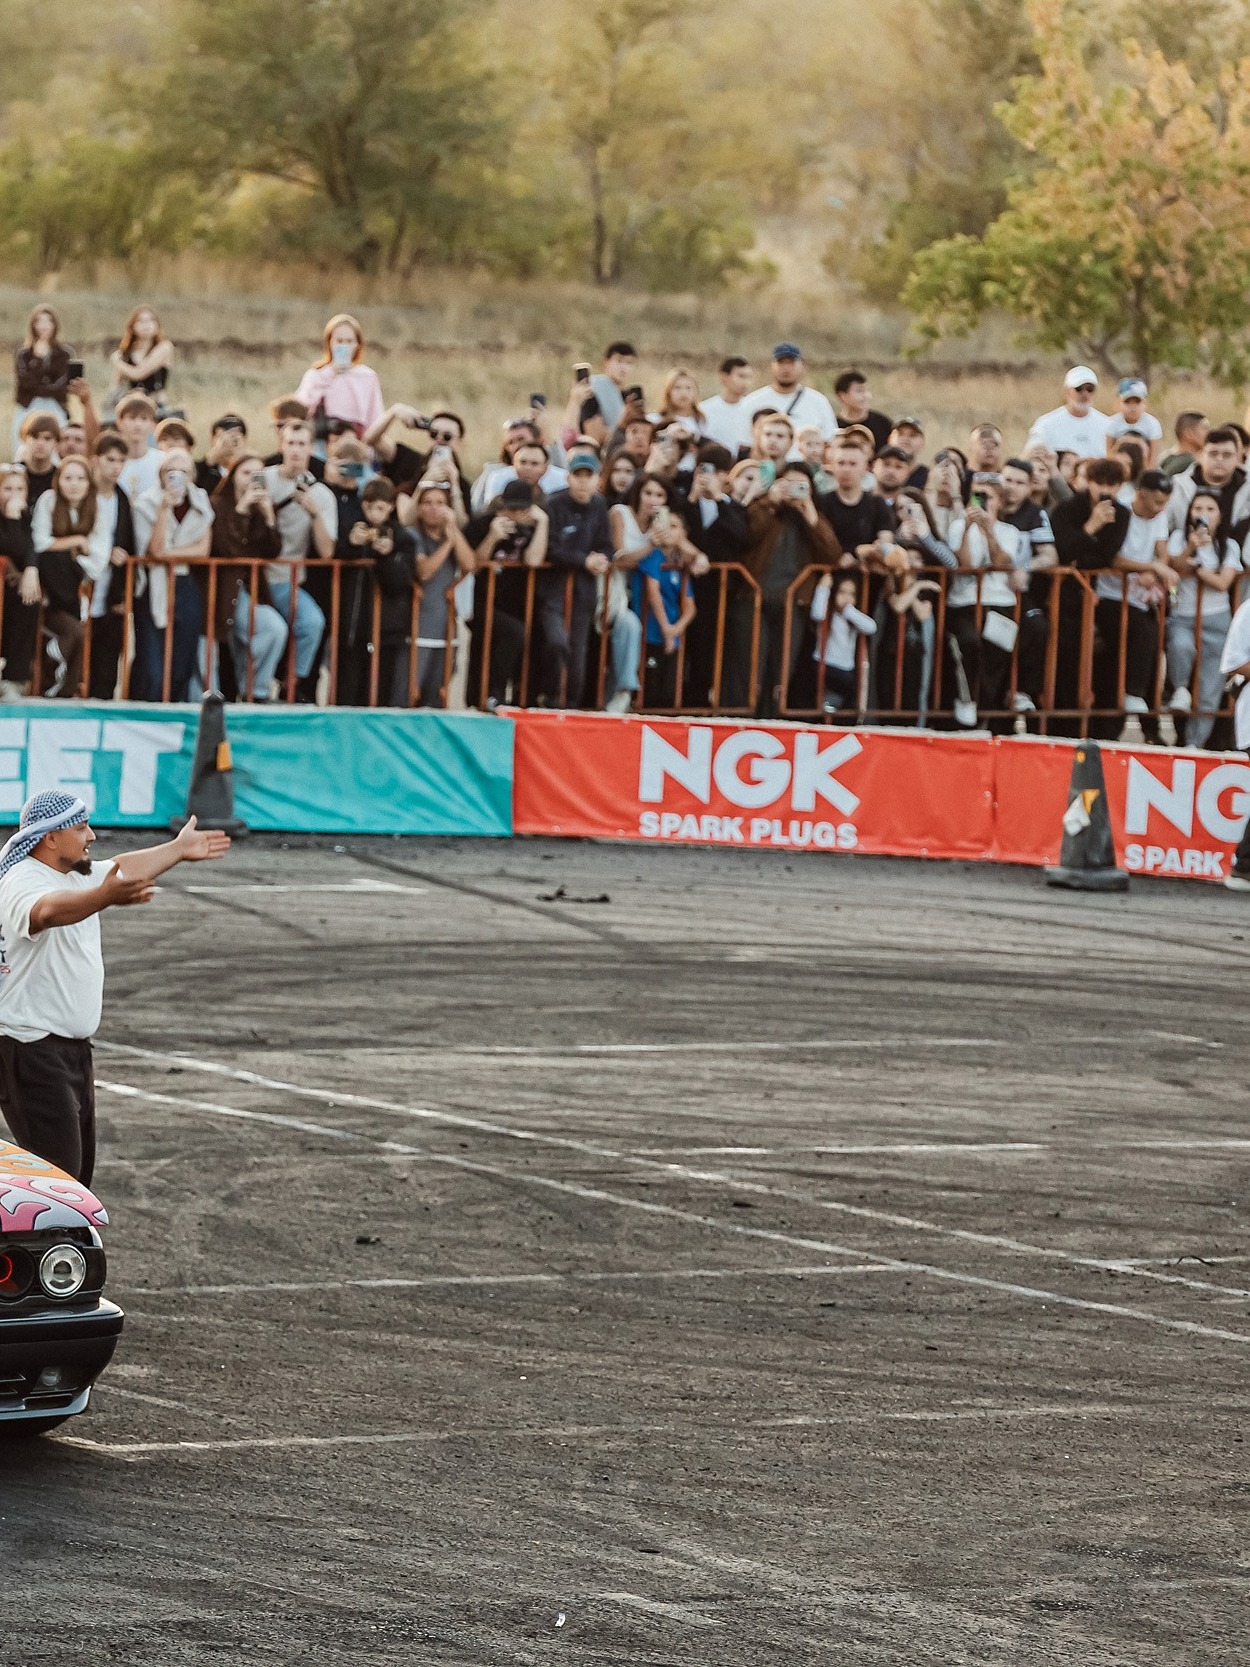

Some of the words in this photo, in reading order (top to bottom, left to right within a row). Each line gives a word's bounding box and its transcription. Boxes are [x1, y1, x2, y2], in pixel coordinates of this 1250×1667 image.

[638, 724, 864, 817] NGK
[638, 811, 745, 843] SPARK
[750, 817, 860, 849] PLUGS
[1123, 843, 1225, 877] SPARK
